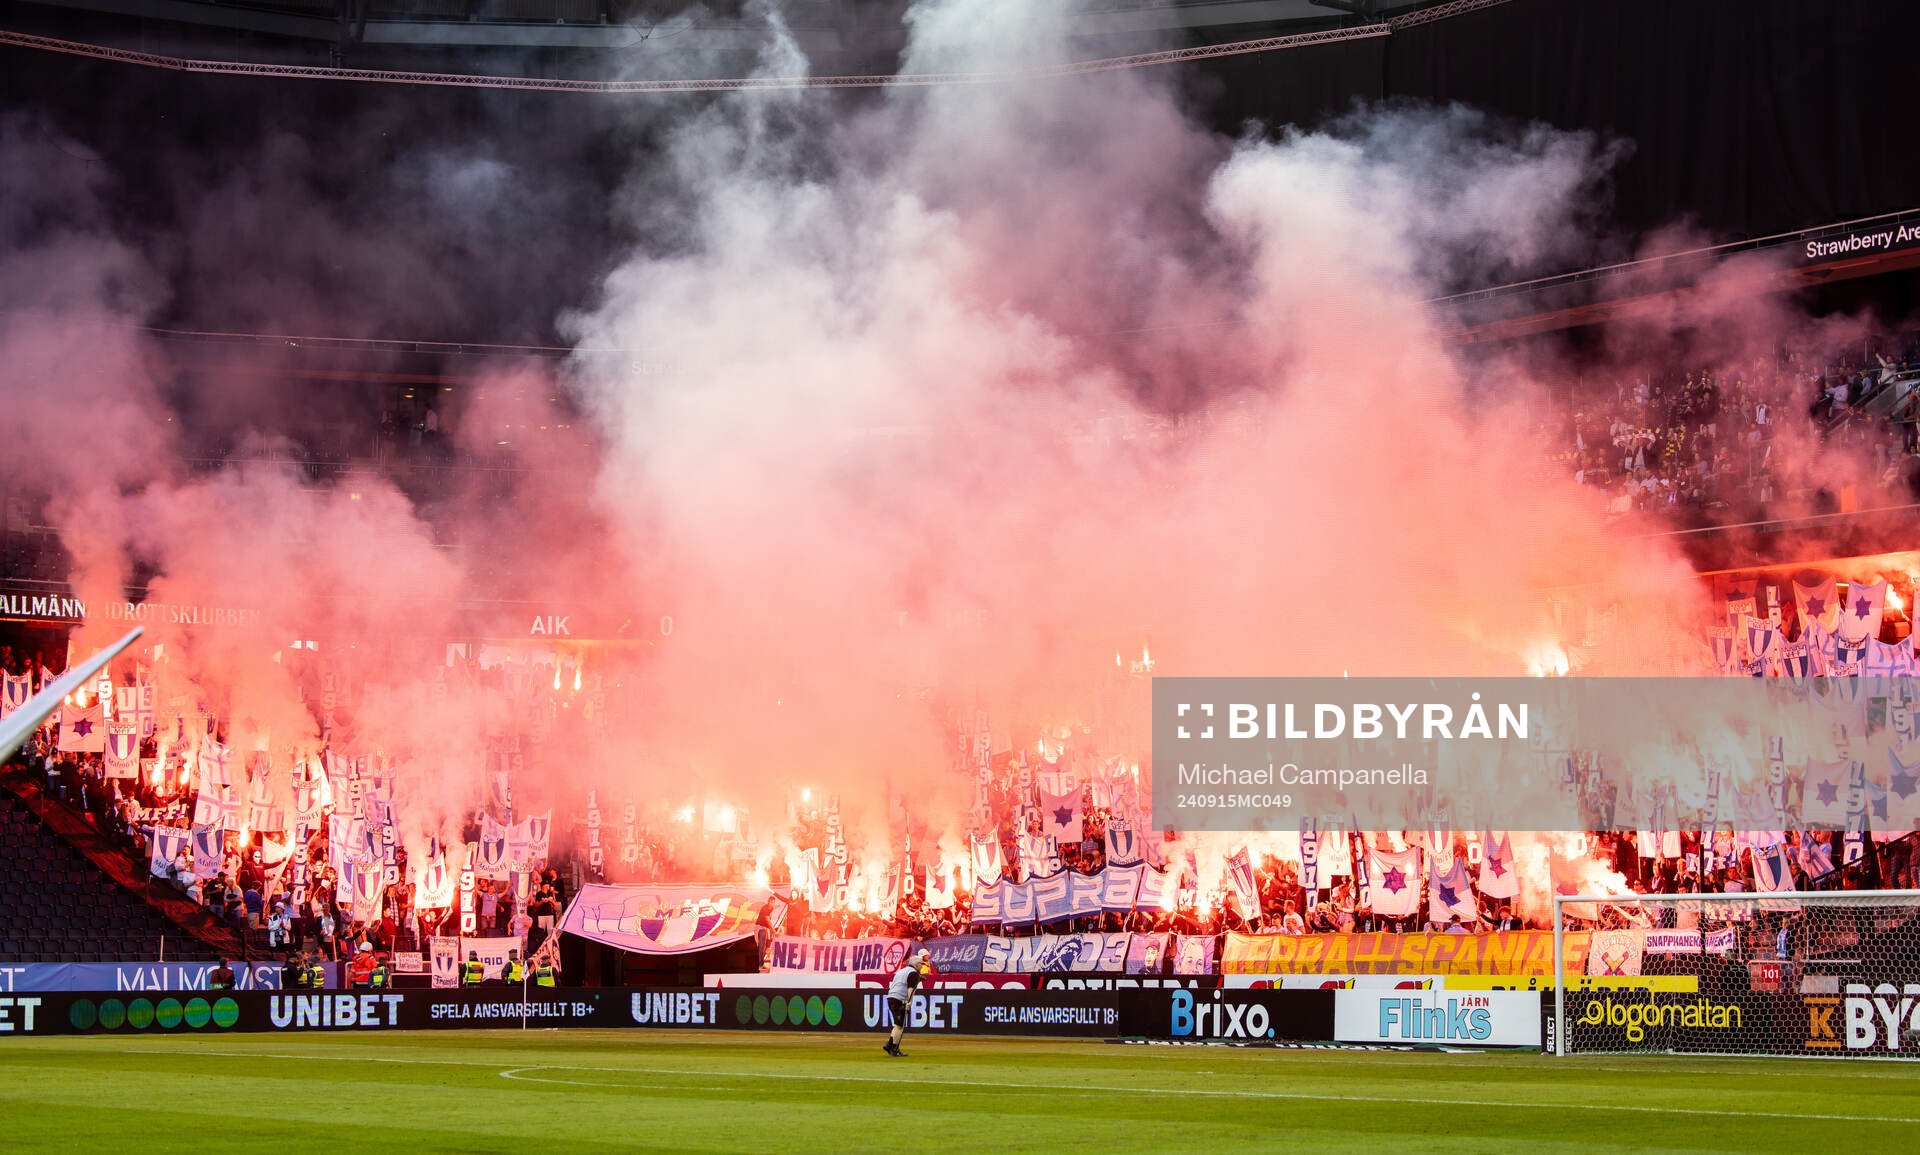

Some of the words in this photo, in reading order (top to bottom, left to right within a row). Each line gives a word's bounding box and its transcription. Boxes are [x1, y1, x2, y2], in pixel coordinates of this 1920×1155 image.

[1806, 230, 1893, 258] Strawberry
[0, 592, 88, 618] ALLMÄNN
[530, 615, 571, 636] AIK
[660, 615, 674, 637] 0
[132, 803, 189, 822] MFF!
[292, 823, 309, 905] 1910
[460, 843, 477, 933] 1910
[773, 941, 807, 969] NEJ
[812, 945, 847, 972] TILL
[853, 943, 884, 972] VAR
[1763, 968, 1780, 980] 101
[270, 994, 404, 1028] UNIBET
[431, 1003, 471, 1019] SPELA
[474, 1002, 567, 1019] ANSVARSFULLT
[571, 1002, 595, 1017] 18+
[631, 992, 721, 1024] UNIBET
[863, 994, 964, 1029] UNBET
[984, 1006, 1017, 1023] SPELA
[1019, 1006, 1100, 1024] ANSVARSFULLT
[1171, 989, 1276, 1039] Brixo.
[1460, 995, 1490, 1008] JÄRN
[1378, 997, 1492, 1041] Flinks
[1546, 1016, 1556, 1053] SELECT
[1606, 996, 1742, 1042] logomattan
[1845, 997, 1920, 1050] BY
